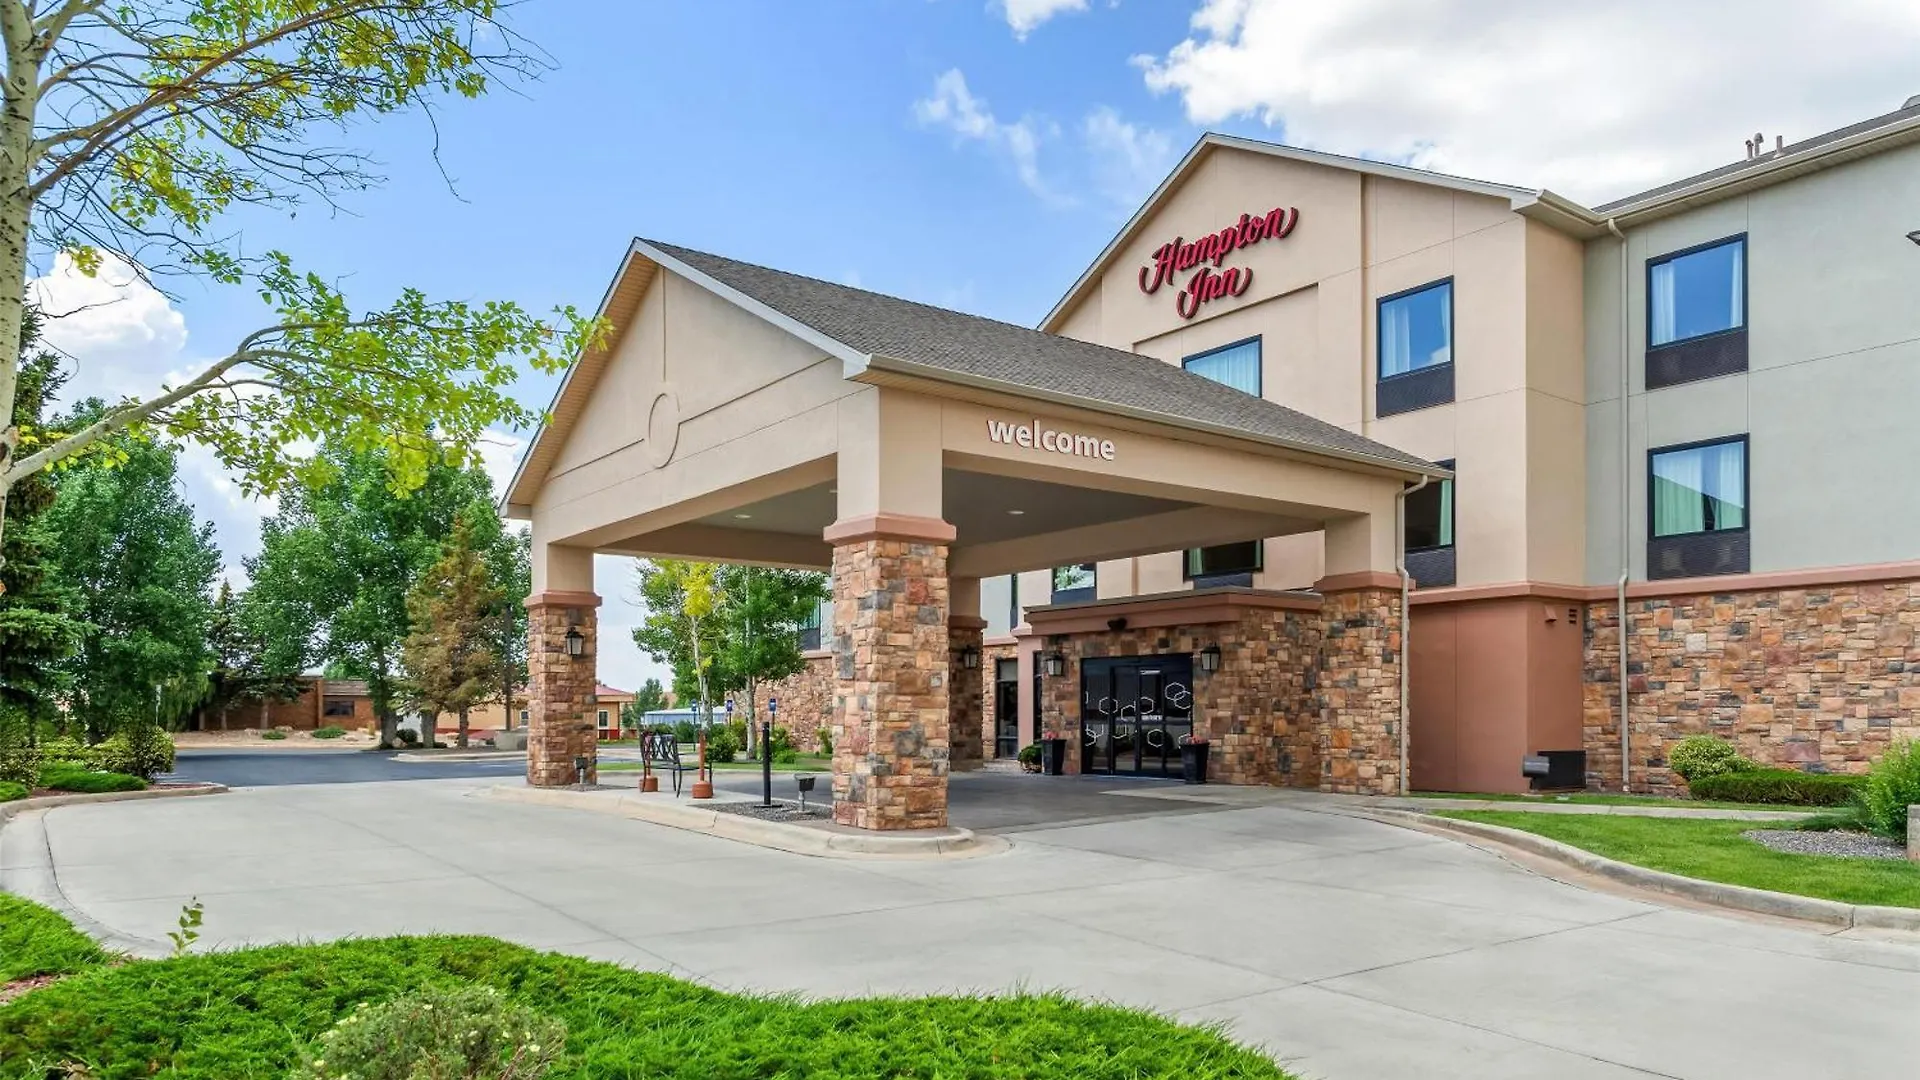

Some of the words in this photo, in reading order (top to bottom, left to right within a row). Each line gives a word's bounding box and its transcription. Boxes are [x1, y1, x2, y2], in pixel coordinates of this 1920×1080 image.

[1139, 207, 1299, 295] Hampton
[1176, 267, 1253, 319] Inn
[987, 419, 1115, 461] welcome
